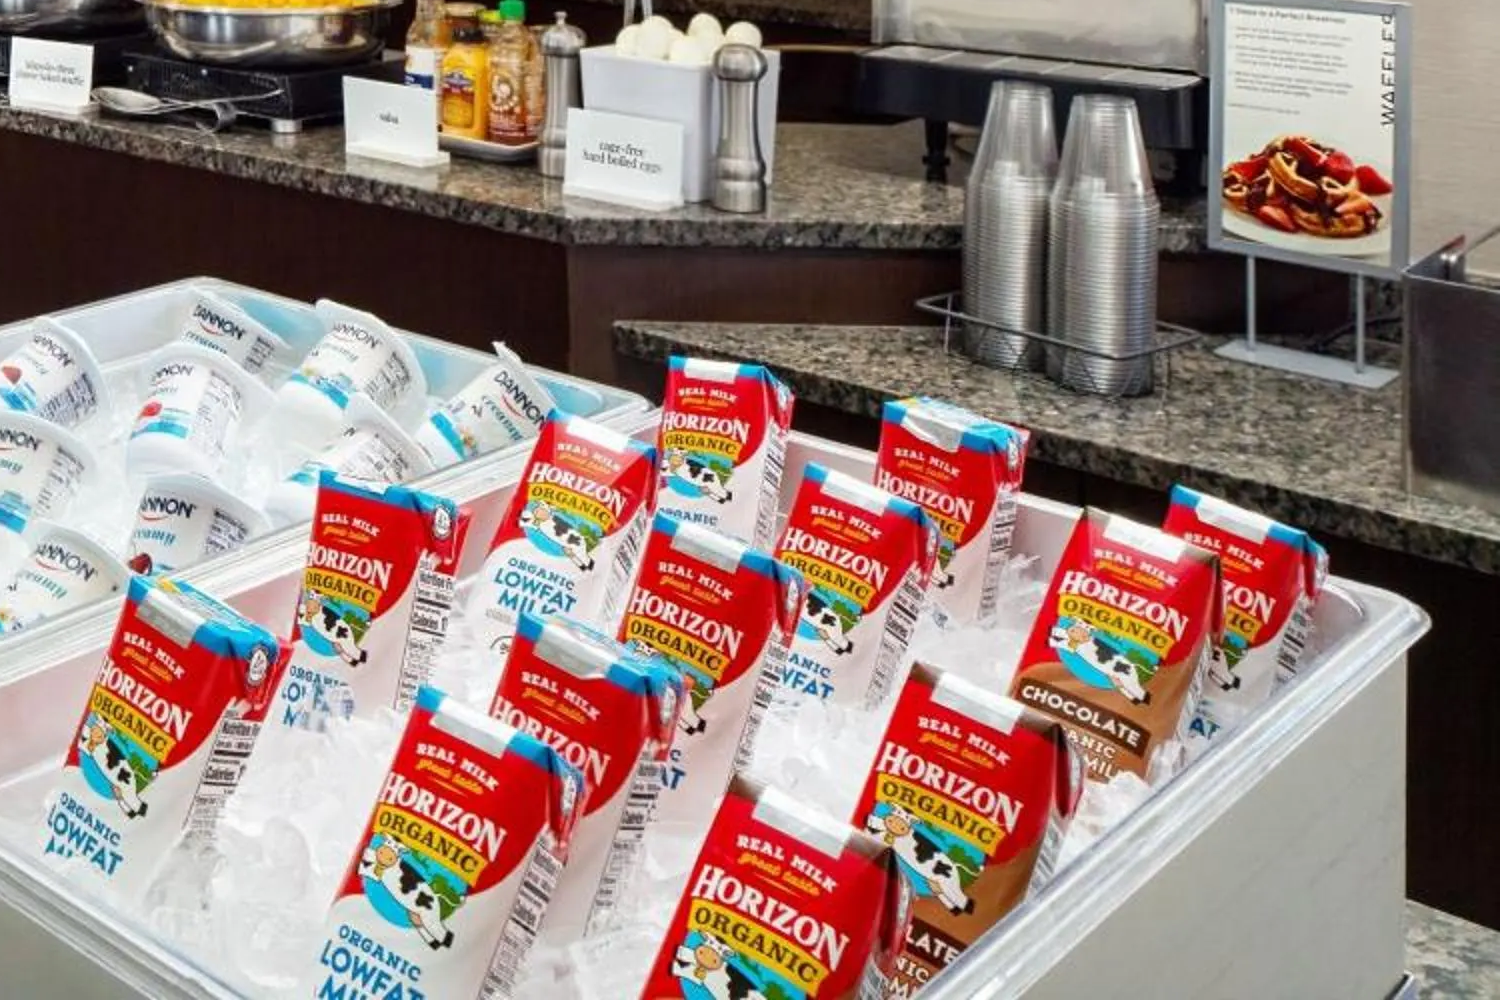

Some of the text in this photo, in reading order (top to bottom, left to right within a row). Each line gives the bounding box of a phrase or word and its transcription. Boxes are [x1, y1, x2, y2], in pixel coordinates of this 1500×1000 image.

[662, 411, 751, 445] HORIZON
[665, 433, 738, 456] ORGANIC
[528, 461, 629, 518] HORIZON
[531, 484, 611, 527] ORGANIC
[876, 467, 976, 526] HORIZON
[303, 540, 394, 592] HORIZON
[304, 571, 376, 606] ORGANIC
[508, 556, 576, 592] ORGANIC
[781, 526, 890, 593] HORIZON
[785, 555, 870, 601] ORGANIC
[494, 567, 578, 613] LOWFAT
[1057, 569, 1190, 643] HORIZON
[627, 586, 744, 662] HORIZON
[630, 618, 724, 673] ORGANIC
[1061, 597, 1170, 651] ORGANIC
[788, 652, 833, 680] ANIC
[94, 692, 169, 753] ORGANIC
[99, 655, 194, 742] HORIZON
[1020, 684, 1143, 749] CHOCOLATE
[416, 743, 501, 793] REAL MILK
[490, 694, 613, 788] HORIZON
[917, 715, 1012, 767] REAL MILK
[1066, 727, 1117, 760] ANIC
[378, 770, 508, 863] HORIZON
[875, 740, 1026, 835] HORIZON
[881, 780, 998, 846] ORGANIC
[379, 811, 479, 875] ORGANIC
[735, 834, 839, 894] REAL MILK
[690, 863, 850, 973] HORIZON
[694, 905, 819, 984] ORGANIC
[338, 923, 423, 983] ORGANIC
